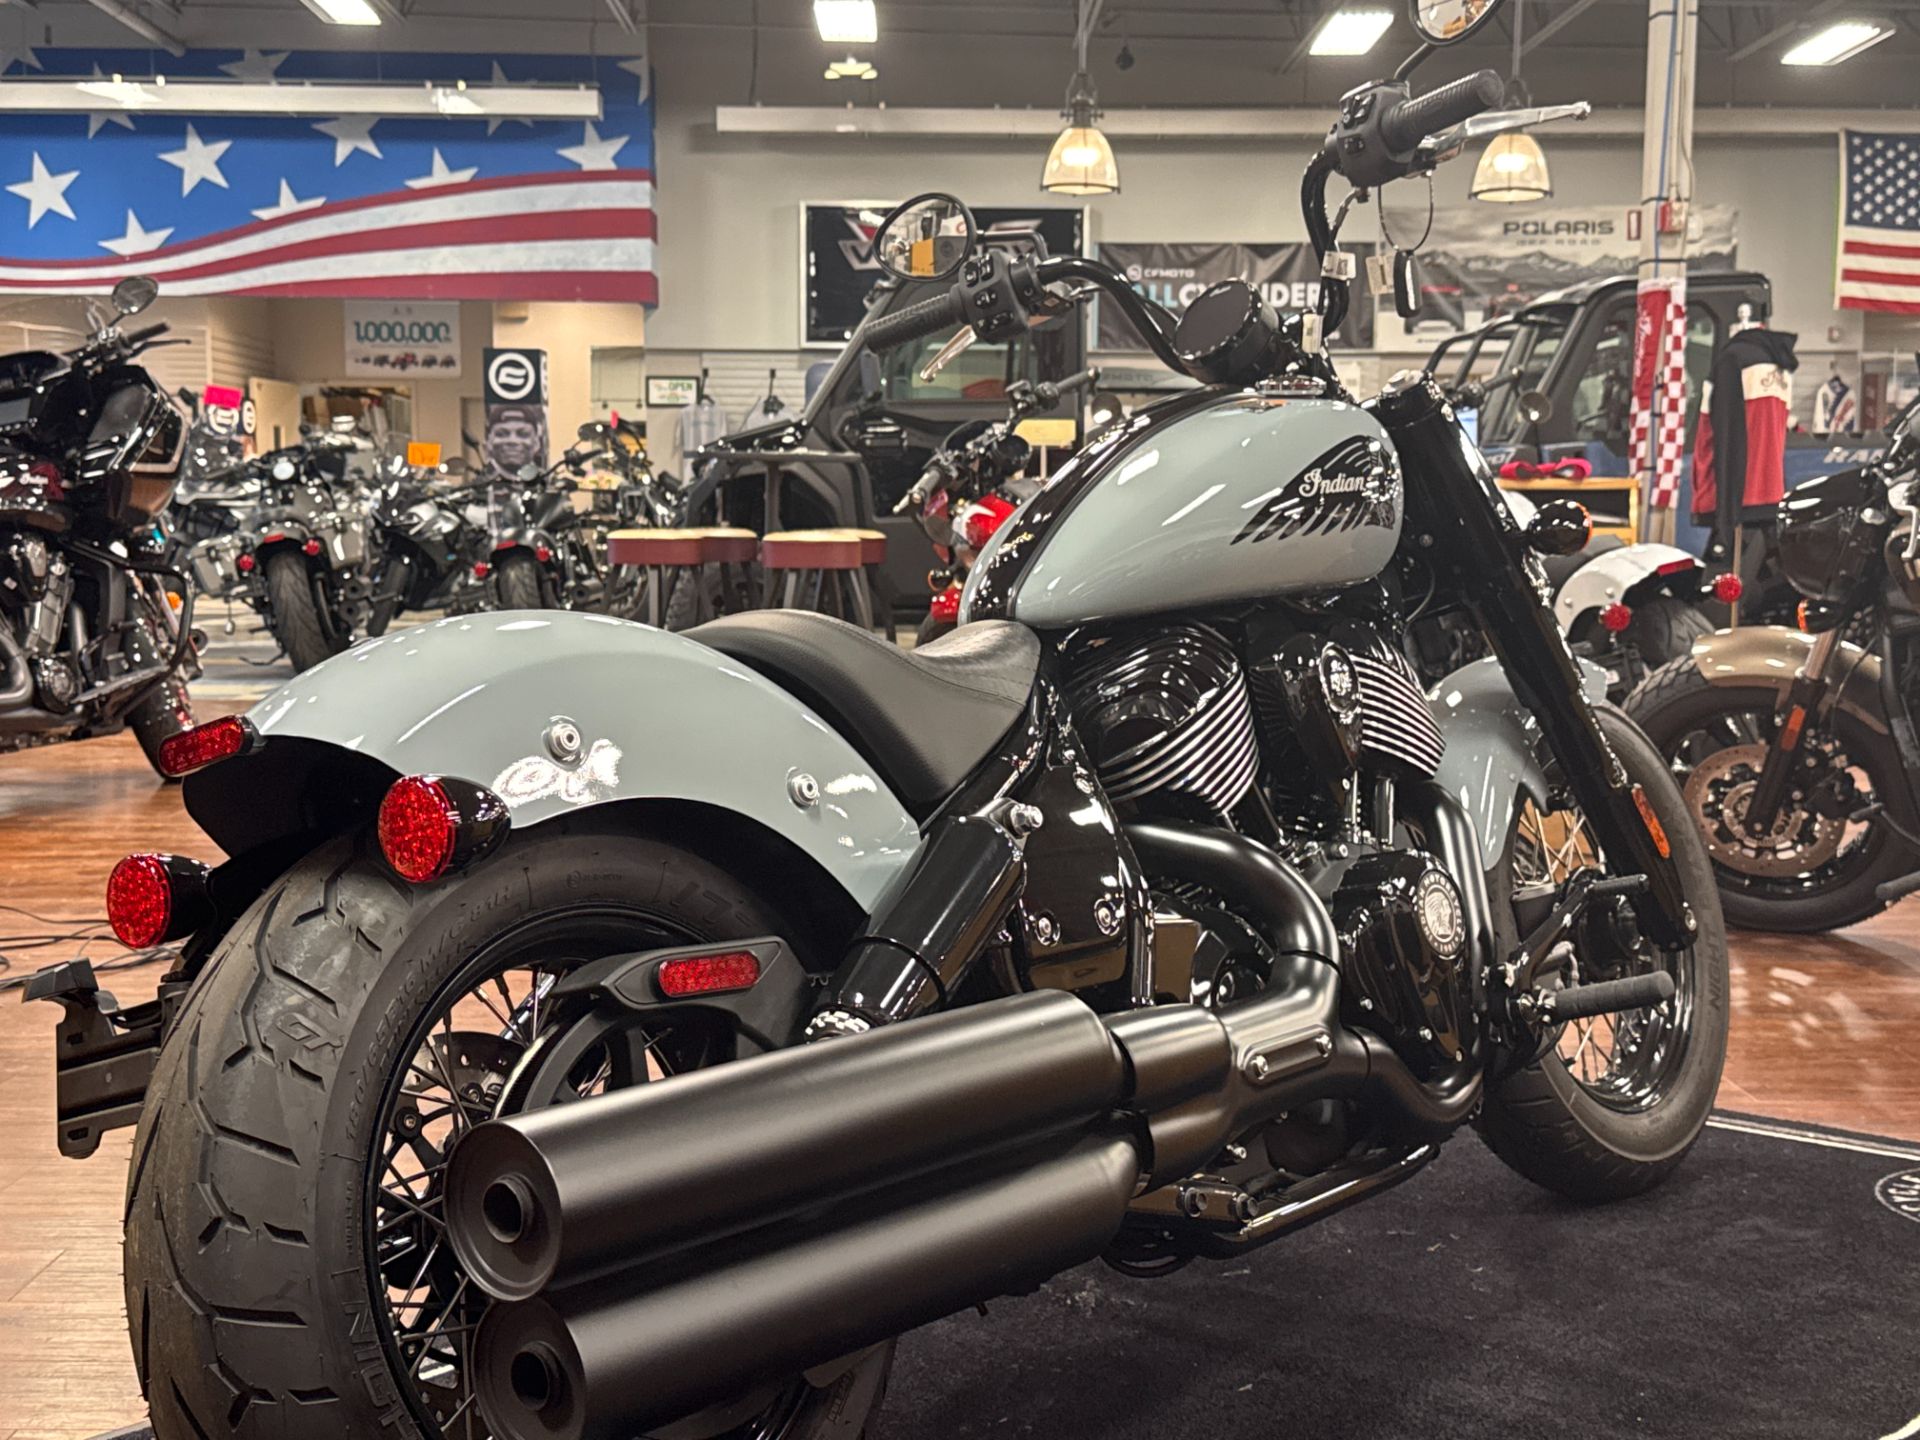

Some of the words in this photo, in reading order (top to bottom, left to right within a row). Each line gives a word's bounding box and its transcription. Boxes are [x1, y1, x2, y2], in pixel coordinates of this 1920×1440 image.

[1503, 220, 1615, 236] POLARIS
[1143, 268, 1196, 279] CFMOTO
[1298, 467, 1366, 498] Indian
